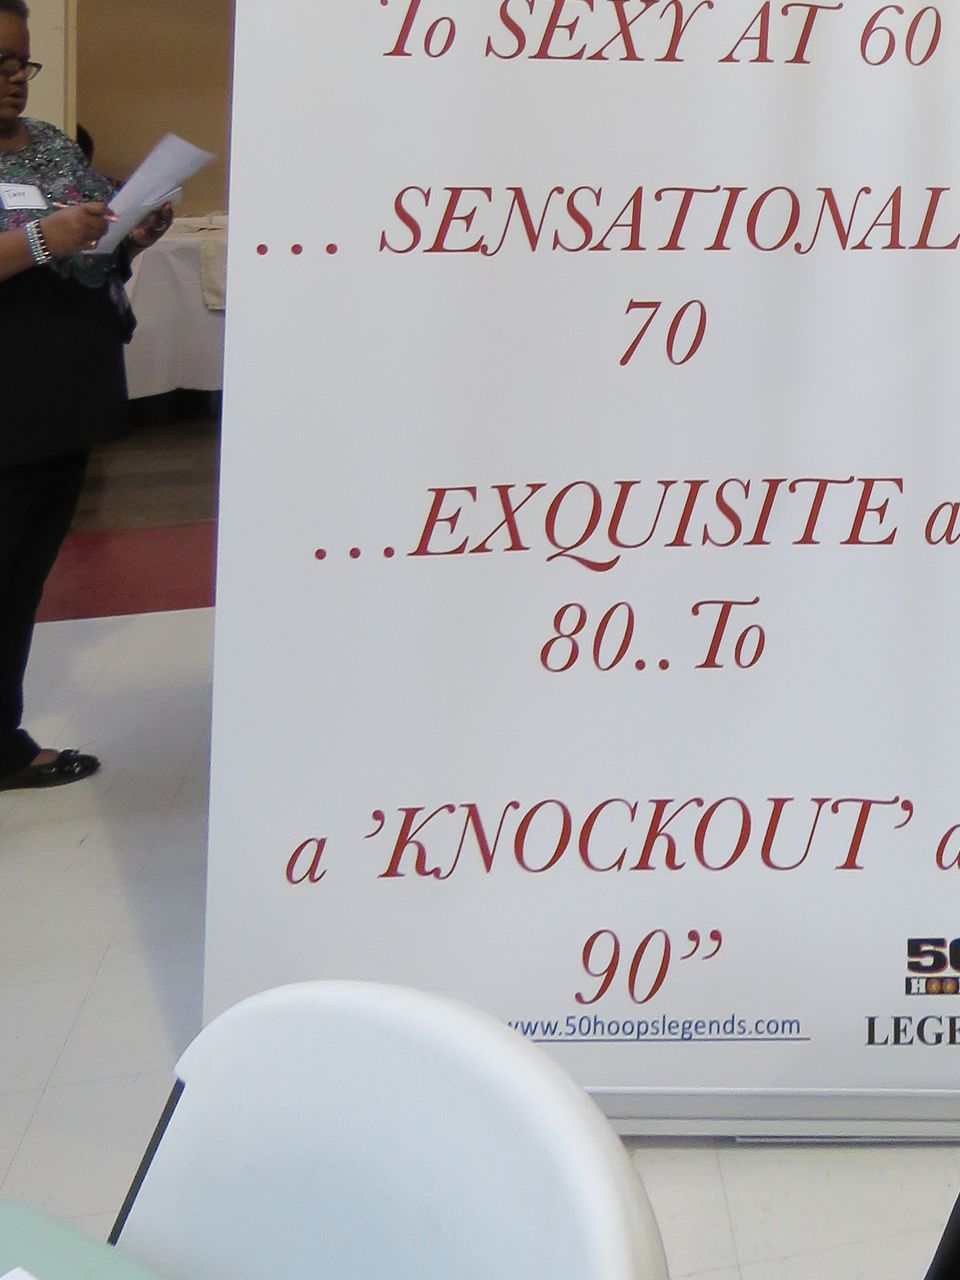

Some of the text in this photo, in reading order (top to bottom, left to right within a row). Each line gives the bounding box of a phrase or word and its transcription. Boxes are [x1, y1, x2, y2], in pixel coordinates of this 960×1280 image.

[719, 1, 844, 65] AT
[859, 4, 943, 66] 60
[379, 185, 960, 256] SENSATIONAL
[619, 299, 708, 367] 70
[540, 596, 767, 672] 80.. To
[285, 835, 327, 884] a
